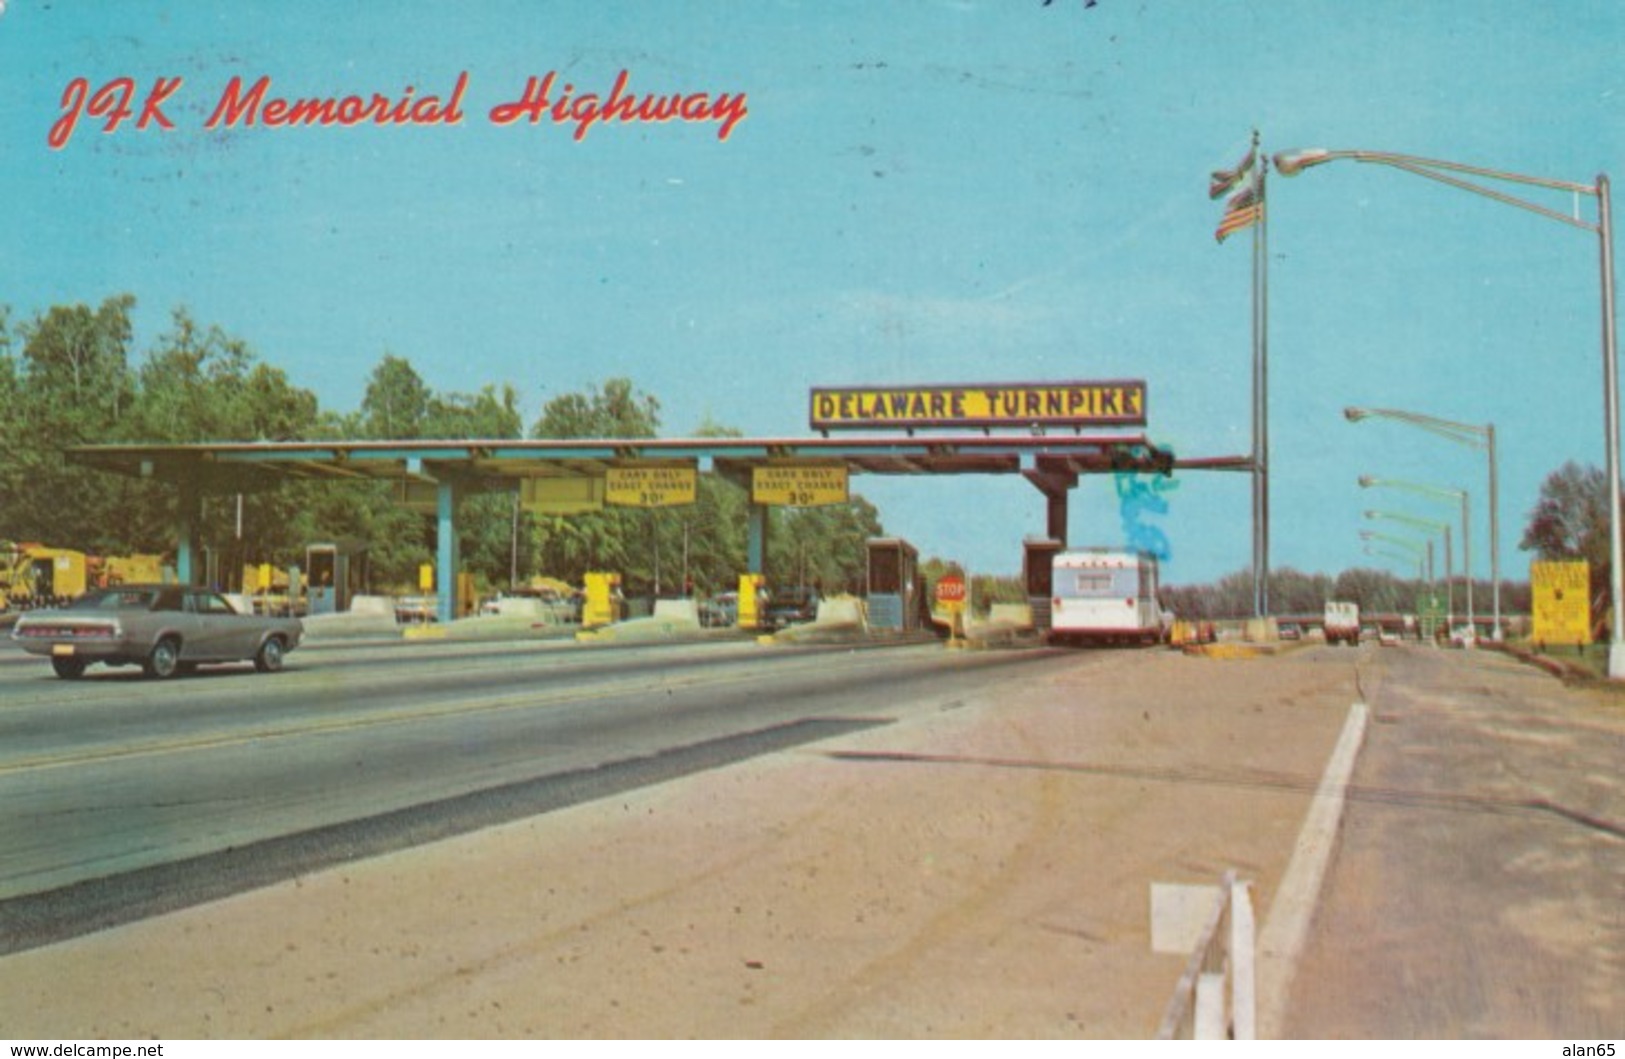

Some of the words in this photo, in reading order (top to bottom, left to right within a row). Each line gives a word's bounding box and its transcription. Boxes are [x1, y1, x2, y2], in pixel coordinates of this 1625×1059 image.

[817, 391, 967, 419] DELAWARE
[984, 388, 1140, 417] TURNPIKE
[937, 583, 965, 596] STOP
